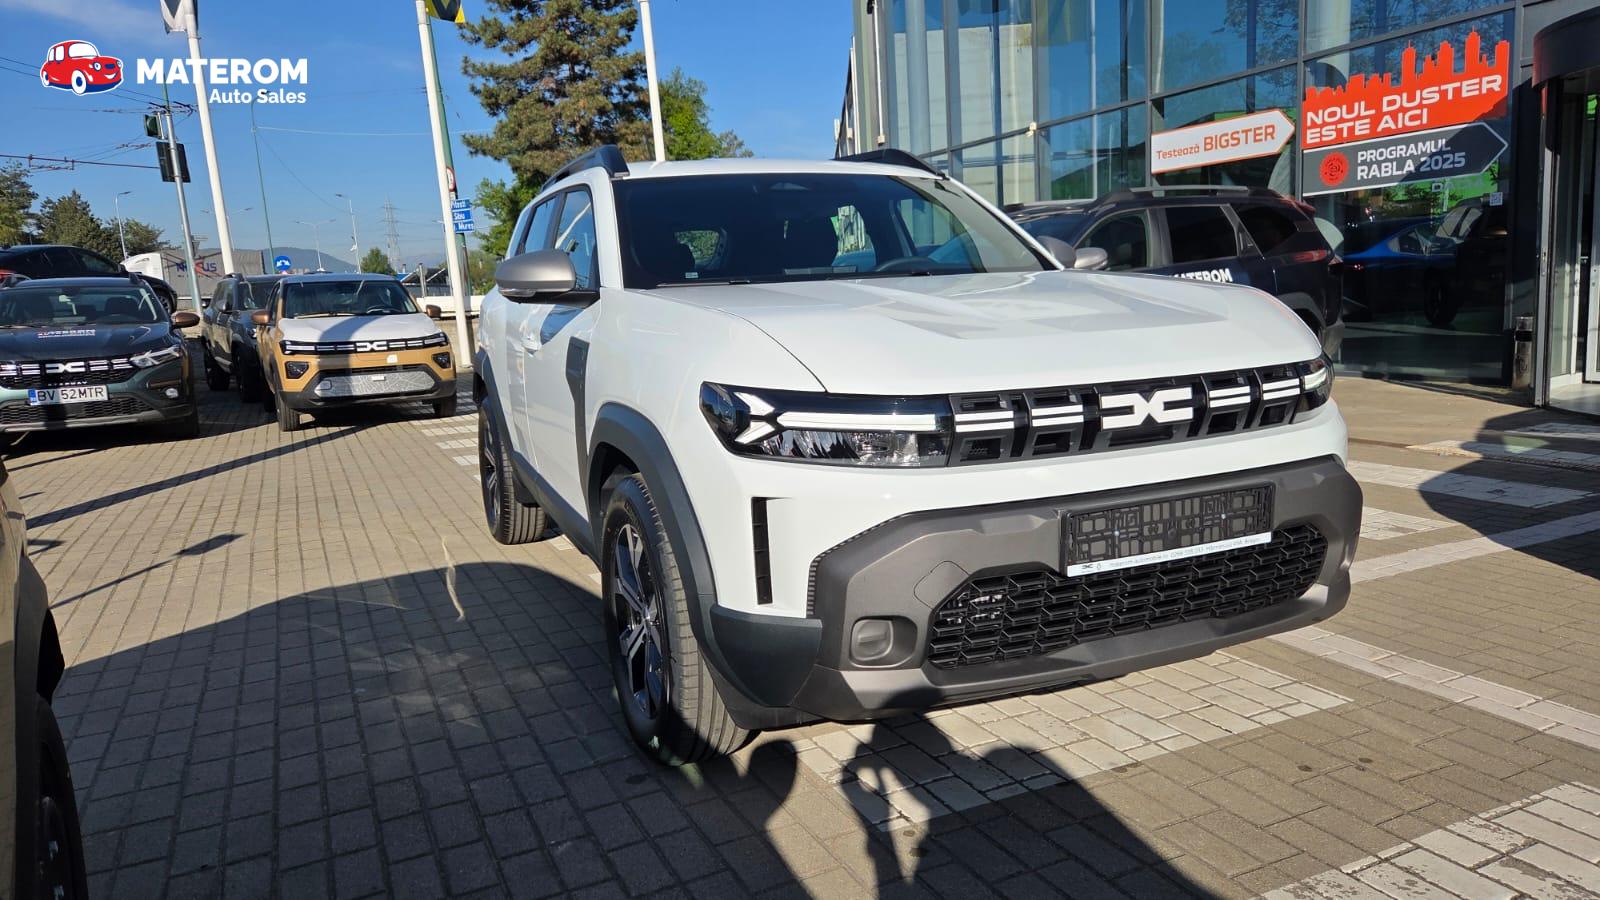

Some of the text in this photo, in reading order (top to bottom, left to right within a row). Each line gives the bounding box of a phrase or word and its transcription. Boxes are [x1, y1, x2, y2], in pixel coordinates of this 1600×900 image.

[1307, 74, 1502, 127] NOUL DUSTER
[1156, 124, 1276, 160] Testează BIGSTER
[1306, 108, 1428, 145] ESTE AICI
[1357, 138, 1451, 163] PROGRAMUL
[1357, 159, 1415, 180] RABLA
[1420, 152, 1466, 172] 2025
[37, 390, 56, 402] BV
